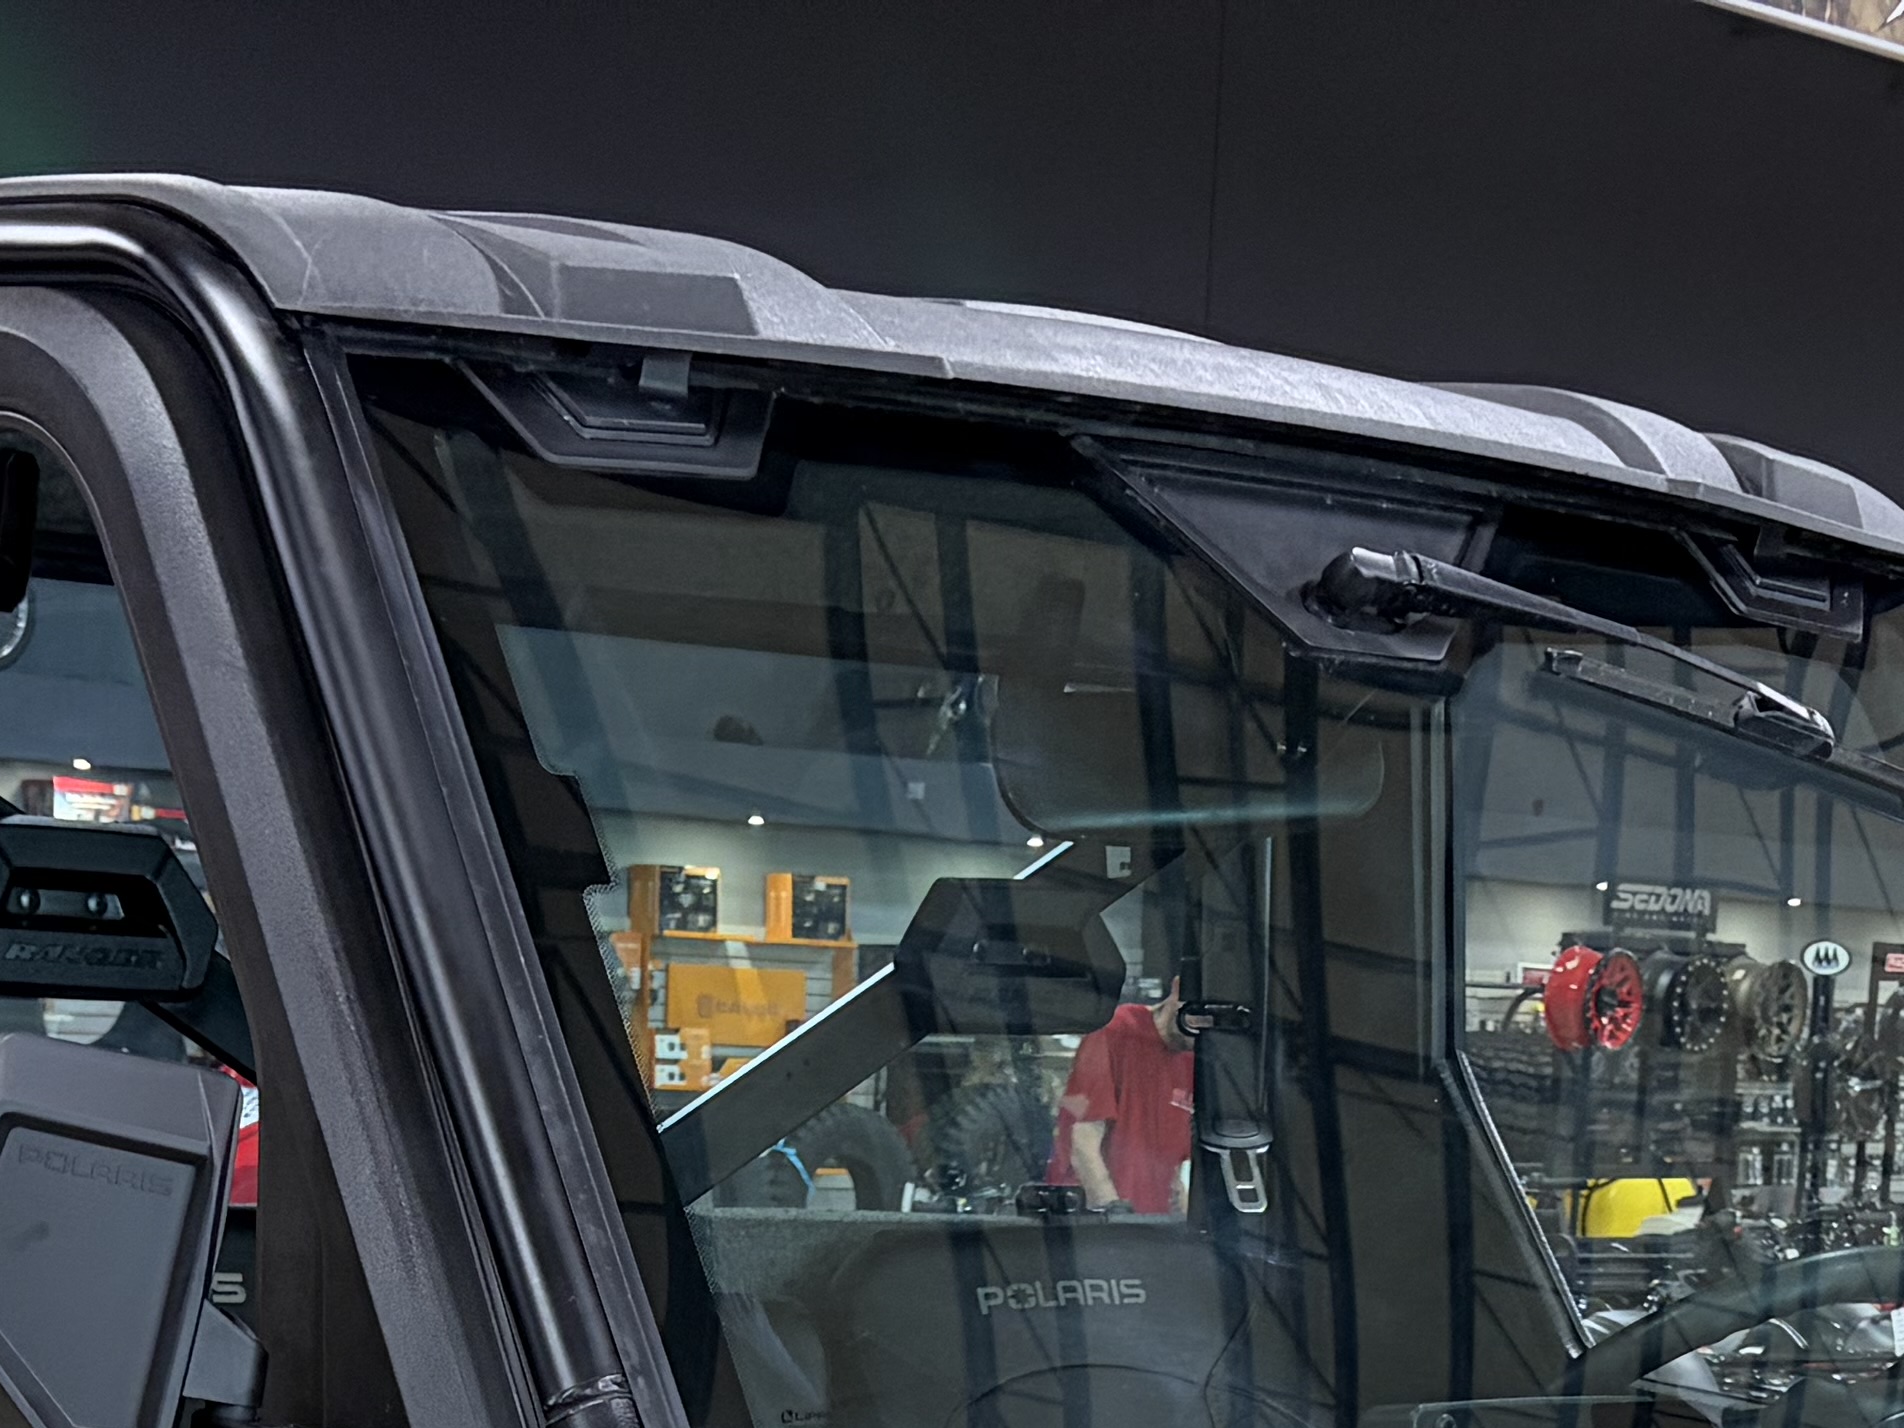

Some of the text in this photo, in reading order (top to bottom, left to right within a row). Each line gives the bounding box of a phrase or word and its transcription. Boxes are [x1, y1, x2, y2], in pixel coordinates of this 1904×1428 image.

[1609, 883, 1712, 916] SEDONA
[18, 1143, 174, 1197] POLARIS
[975, 1278, 1147, 1316] POLARIS
